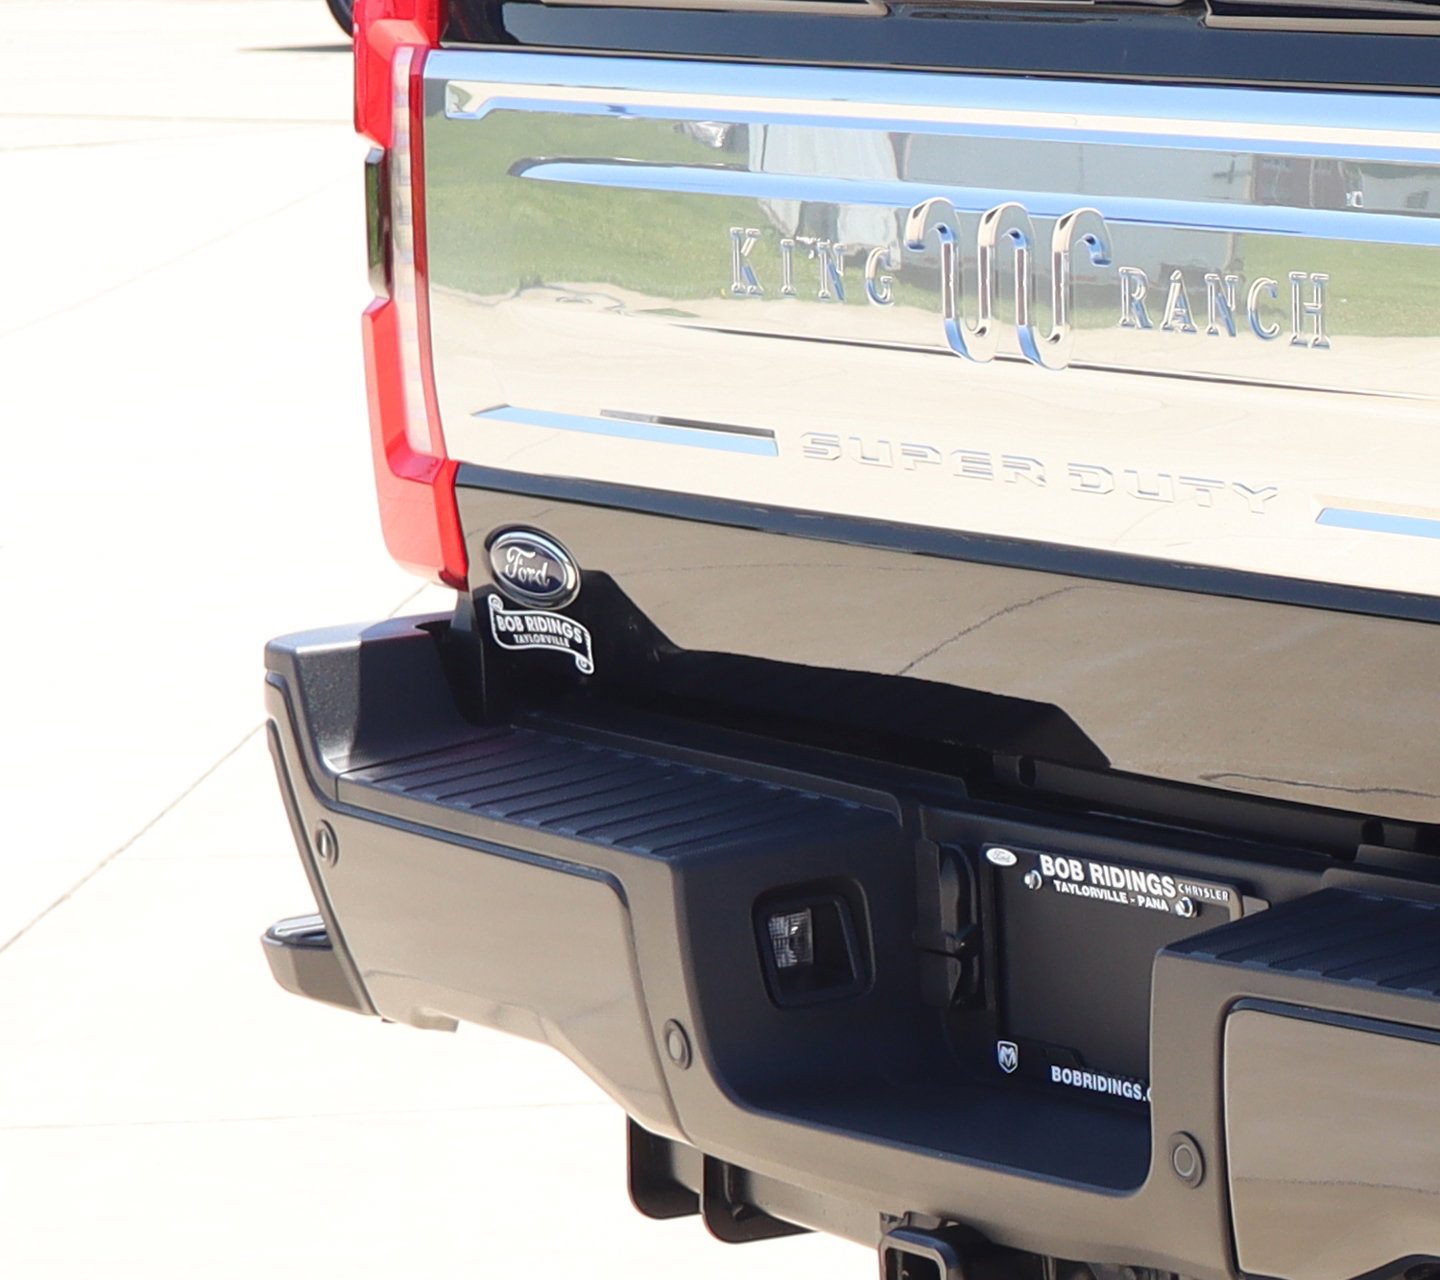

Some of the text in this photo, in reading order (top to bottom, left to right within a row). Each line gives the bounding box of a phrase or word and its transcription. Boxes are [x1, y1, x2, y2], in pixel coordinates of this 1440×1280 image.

[729, 226, 1332, 350] KING RANCH
[800, 431, 1279, 514] SUPER DUTY
[505, 546, 550, 587] Ford
[496, 614, 583, 644] BOB RIDINGS
[513, 634, 570, 648] TAYLORVILLE
[1039, 854, 1230, 902] BOB RIDINGS CHRYSLER
[1053, 879, 1128, 904] TAYLORVILLE
[1137, 895, 1170, 912] PANA
